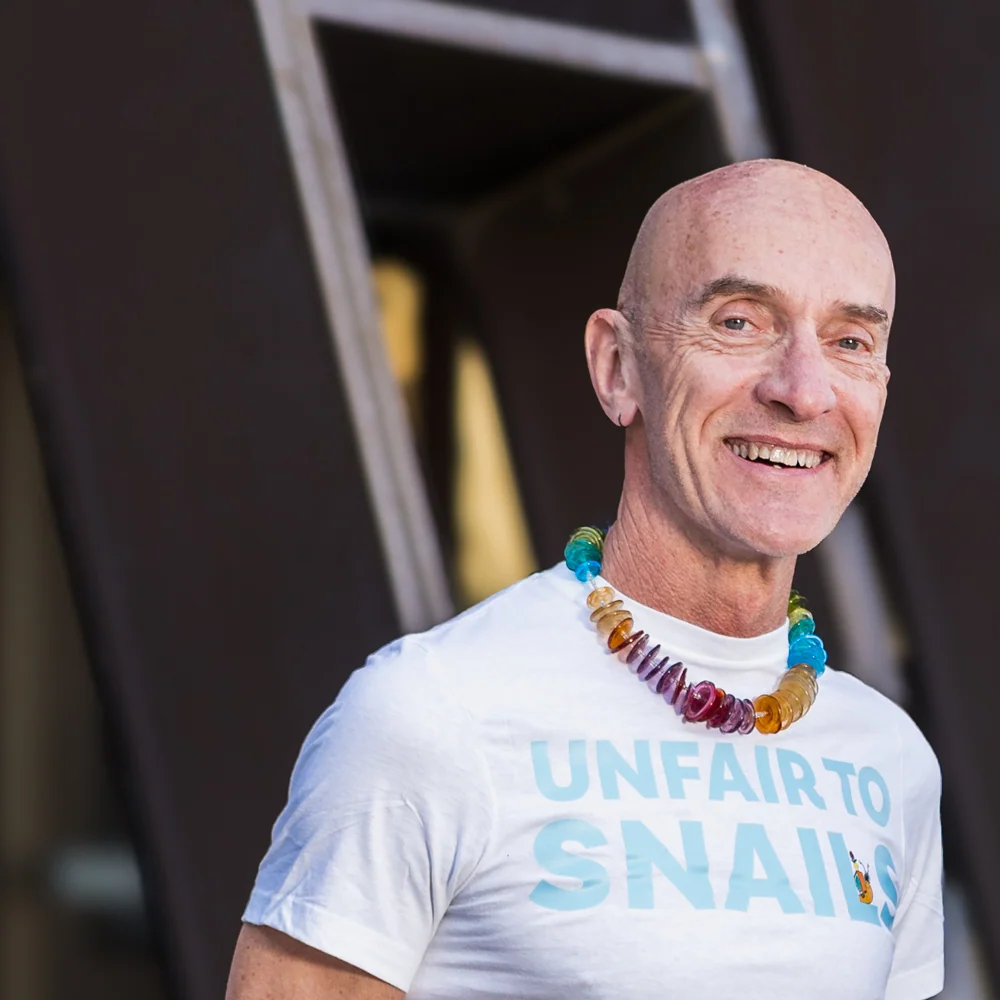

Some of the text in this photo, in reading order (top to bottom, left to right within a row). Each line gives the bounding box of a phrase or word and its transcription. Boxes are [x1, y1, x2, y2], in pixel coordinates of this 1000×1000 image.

[530, 739, 891, 828] UNFAIR TO
[528, 818, 899, 931] SNAILS
